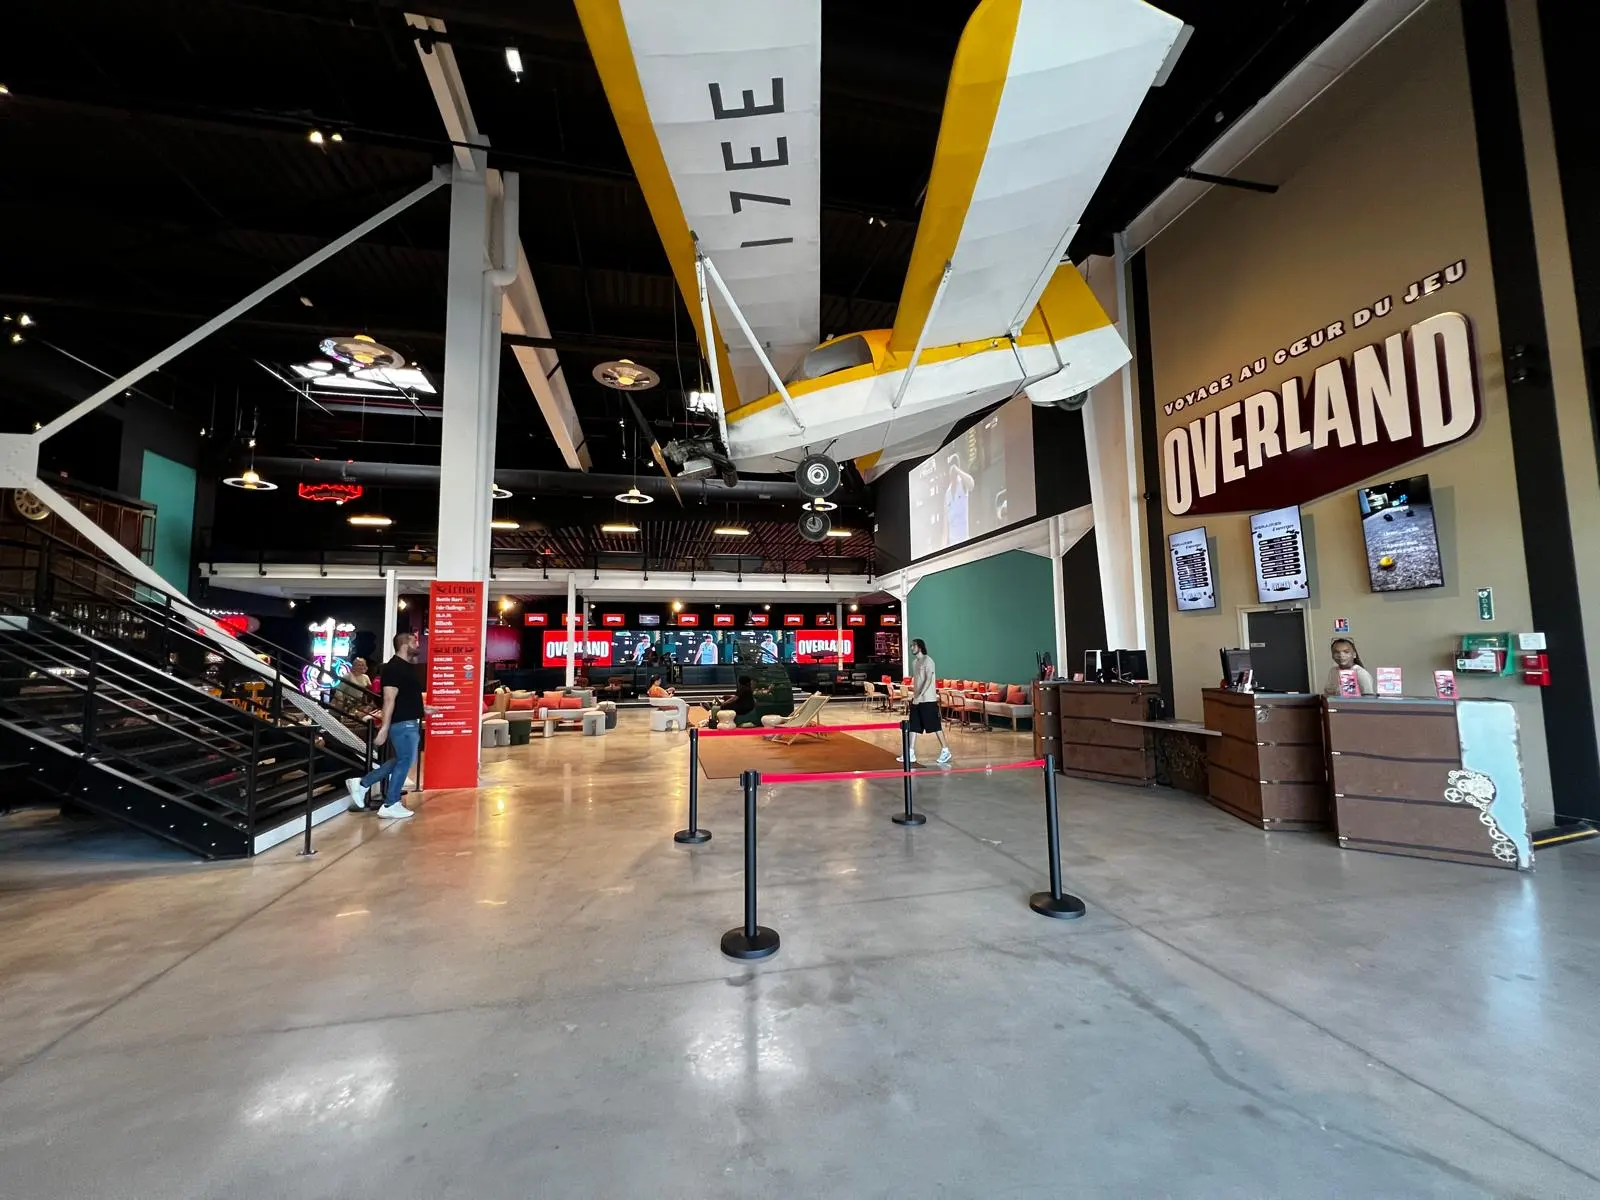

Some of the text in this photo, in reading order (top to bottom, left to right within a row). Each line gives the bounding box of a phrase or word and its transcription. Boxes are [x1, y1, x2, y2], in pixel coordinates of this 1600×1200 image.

[1163, 311, 1476, 515] OVERLAND
[1164, 259, 1466, 416] VOYAGE AU CŒUR DU JEU
[546, 641, 609, 659] OVELAND
